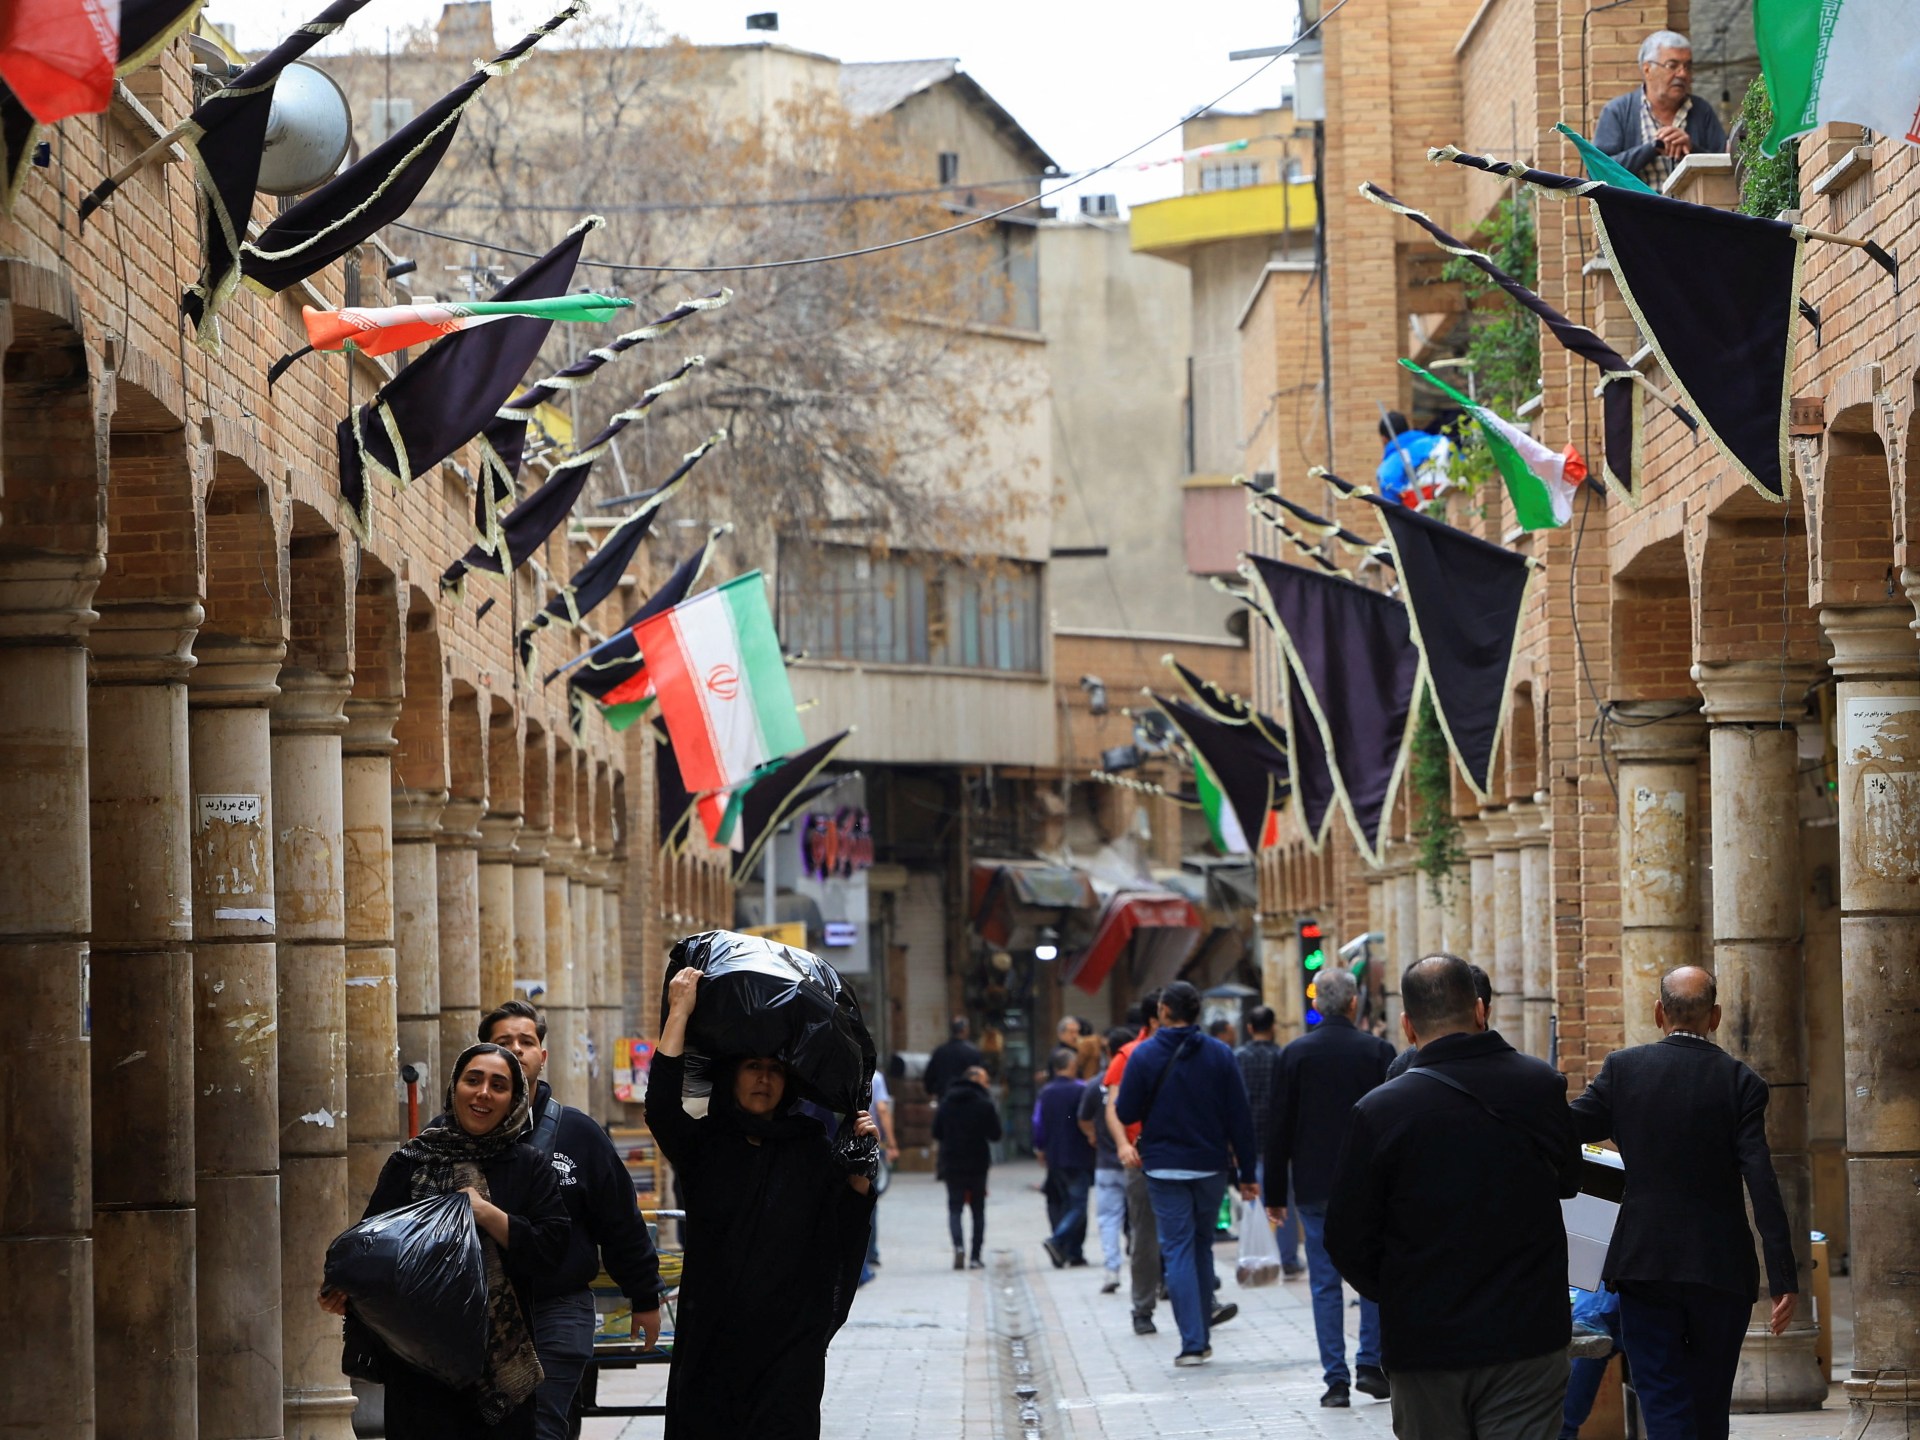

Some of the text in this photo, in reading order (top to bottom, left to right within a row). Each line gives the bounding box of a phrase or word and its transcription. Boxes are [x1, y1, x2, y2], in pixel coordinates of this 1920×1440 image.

[205, 800, 256, 811] انواع مروارید
[553, 1152, 577, 1169] ERDRY
